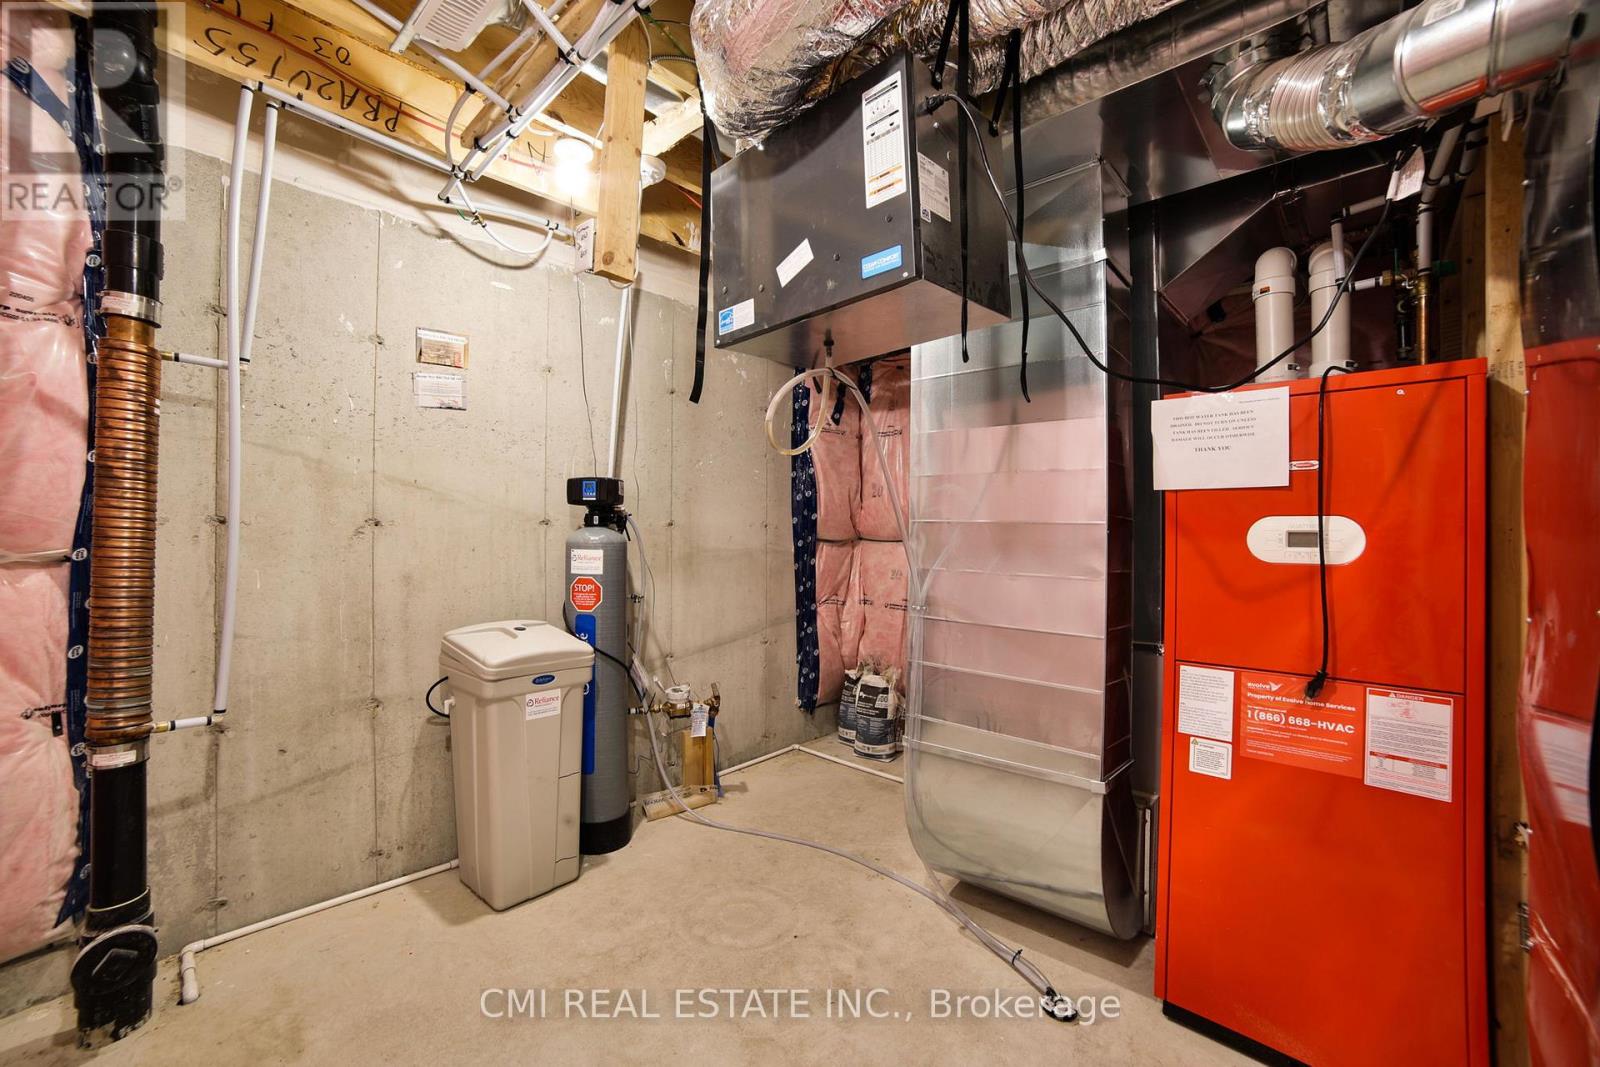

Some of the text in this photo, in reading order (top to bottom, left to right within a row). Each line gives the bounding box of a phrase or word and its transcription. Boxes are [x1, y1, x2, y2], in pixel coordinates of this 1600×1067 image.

[574, 584, 595, 592] STOP!
[535, 696, 559, 704] Reliance
[1248, 692, 1274, 701] Property
[1326, 702, 1356, 712] Services
[1248, 710, 1251, 718] 1
[1255, 710, 1285, 724] (866)
[1289, 716, 1355, 734] 668-HVAC
